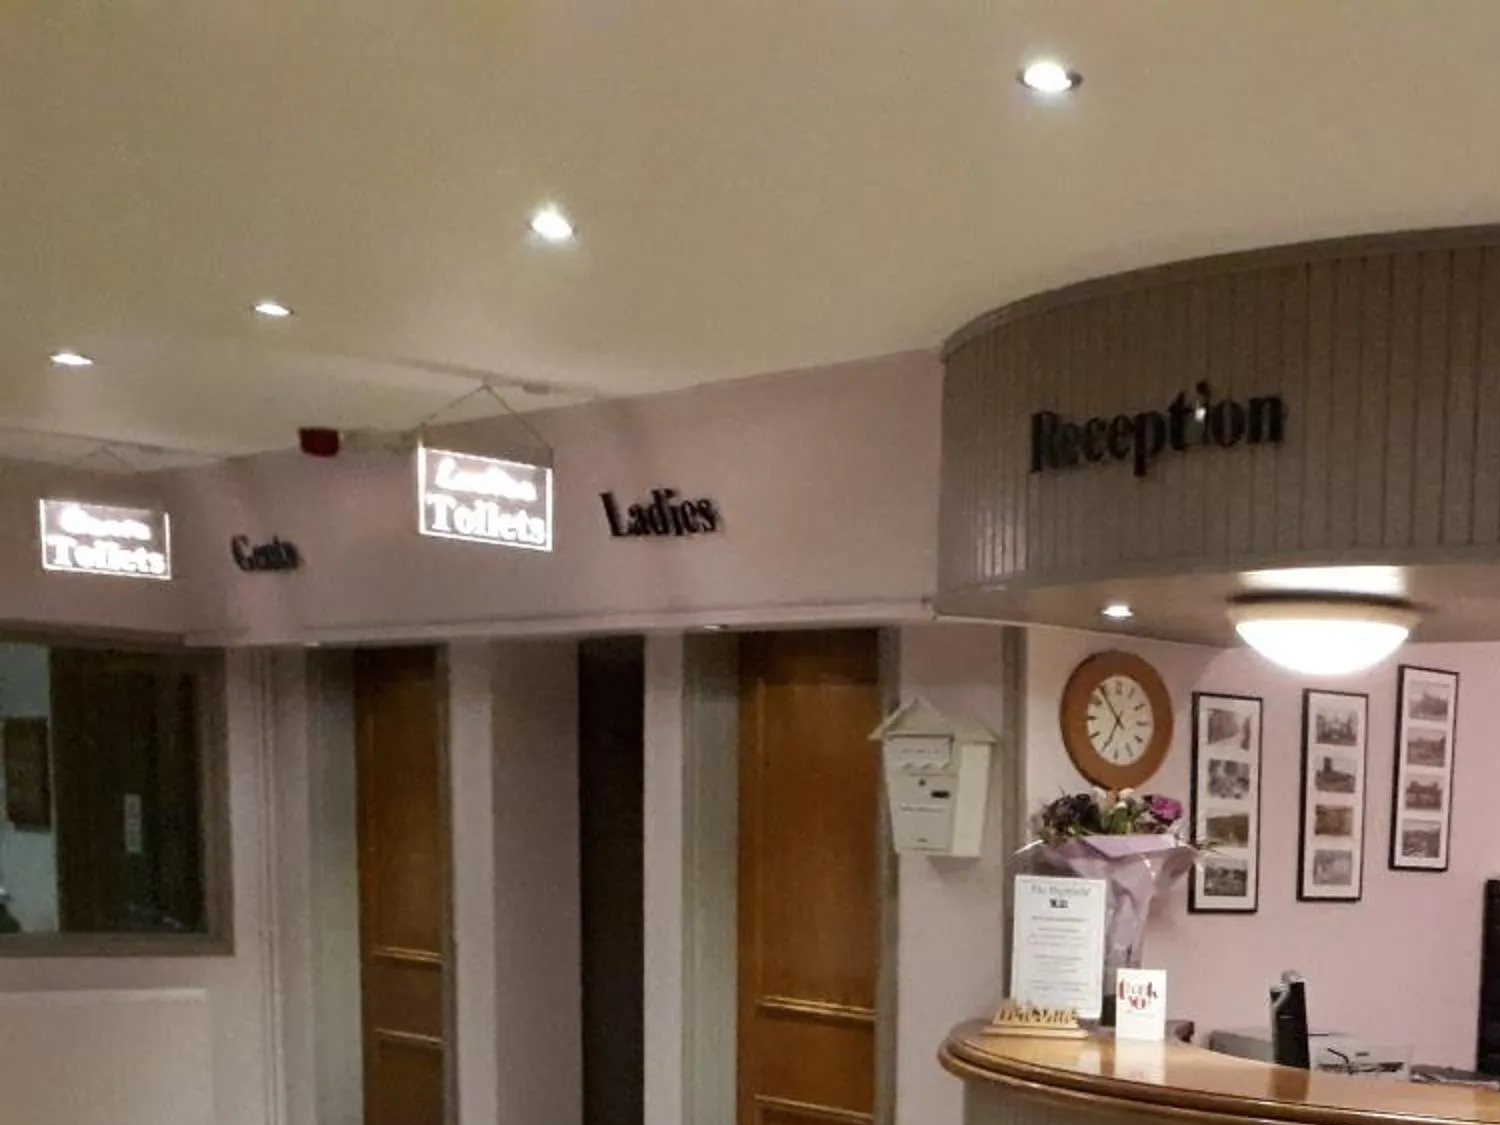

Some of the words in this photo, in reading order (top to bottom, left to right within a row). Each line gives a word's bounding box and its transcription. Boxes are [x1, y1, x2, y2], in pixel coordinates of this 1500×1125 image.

[1030, 380, 1288, 477] Reception
[425, 492, 547, 545] Toilets
[599, 486, 720, 538] Ladies
